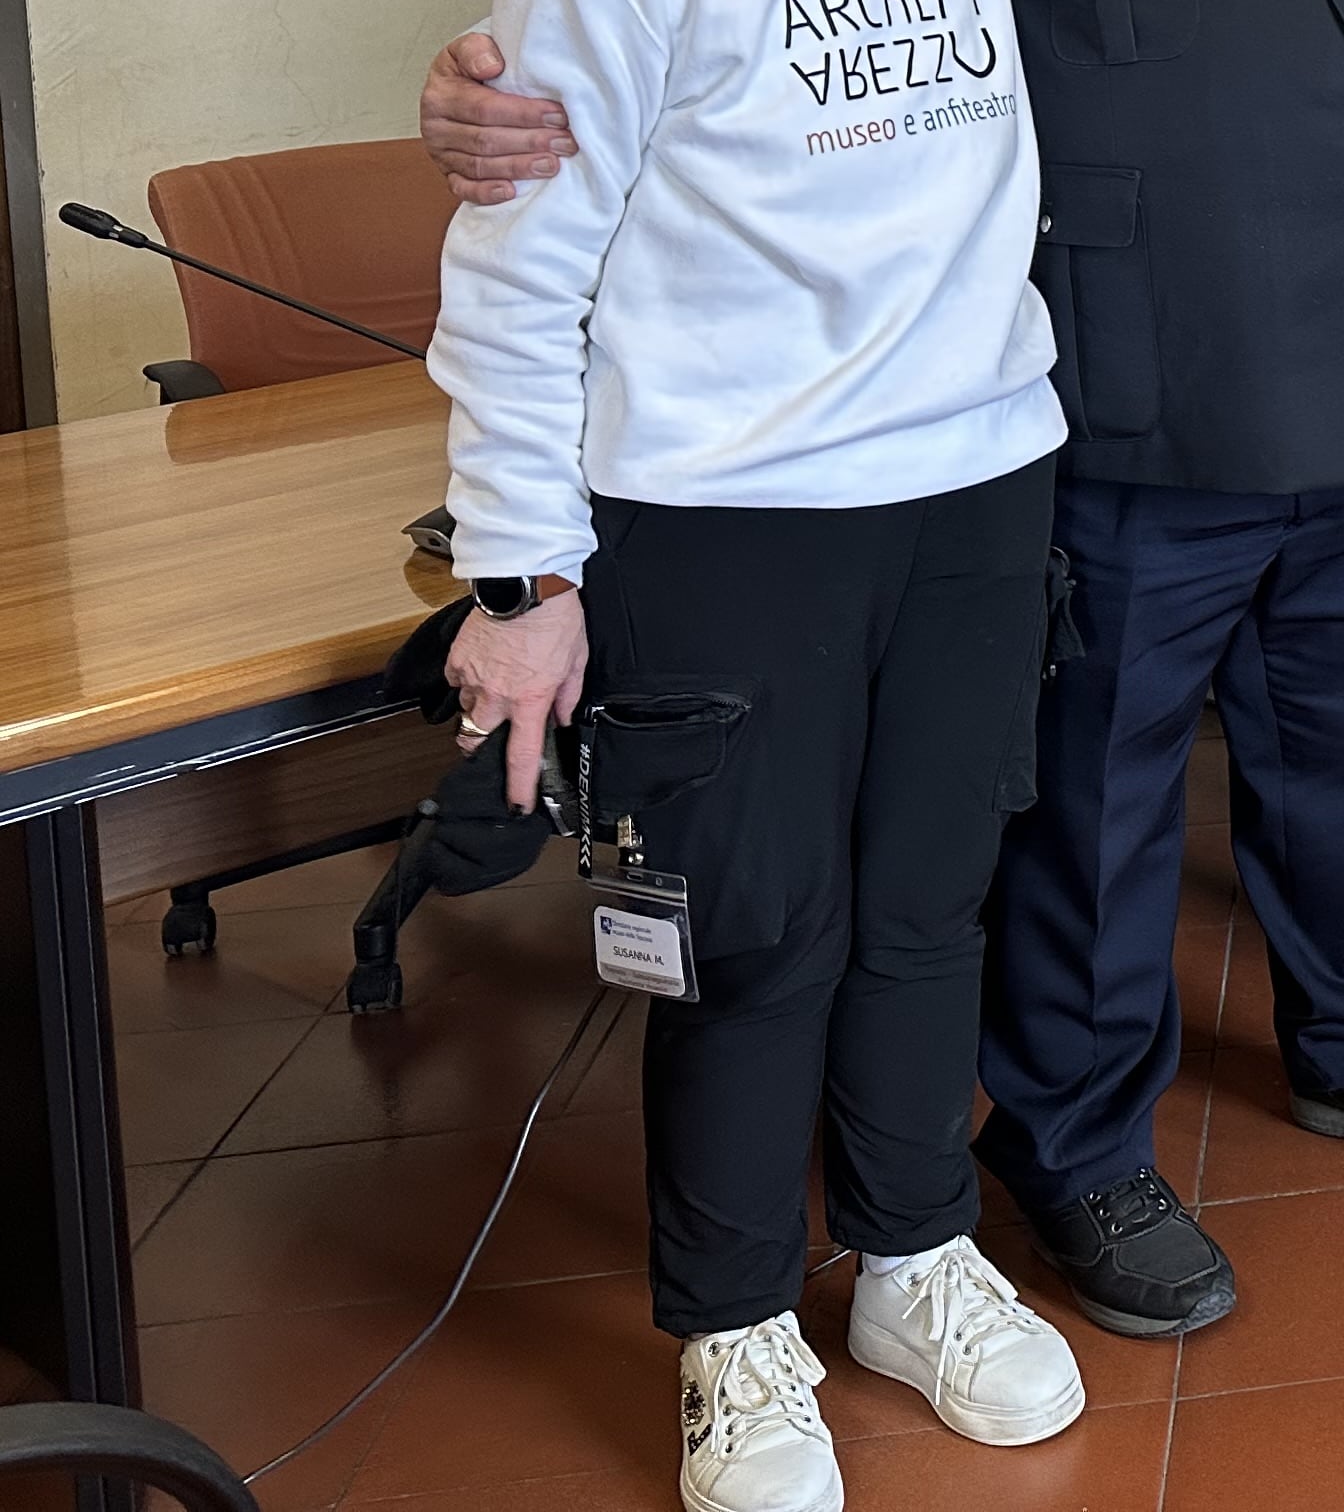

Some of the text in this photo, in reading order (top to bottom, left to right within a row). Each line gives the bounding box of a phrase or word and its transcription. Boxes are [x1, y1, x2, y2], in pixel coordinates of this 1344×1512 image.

[806, 91, 1018, 156] museo e anfiteatro
[613, 945, 653, 964] SUSANNA
